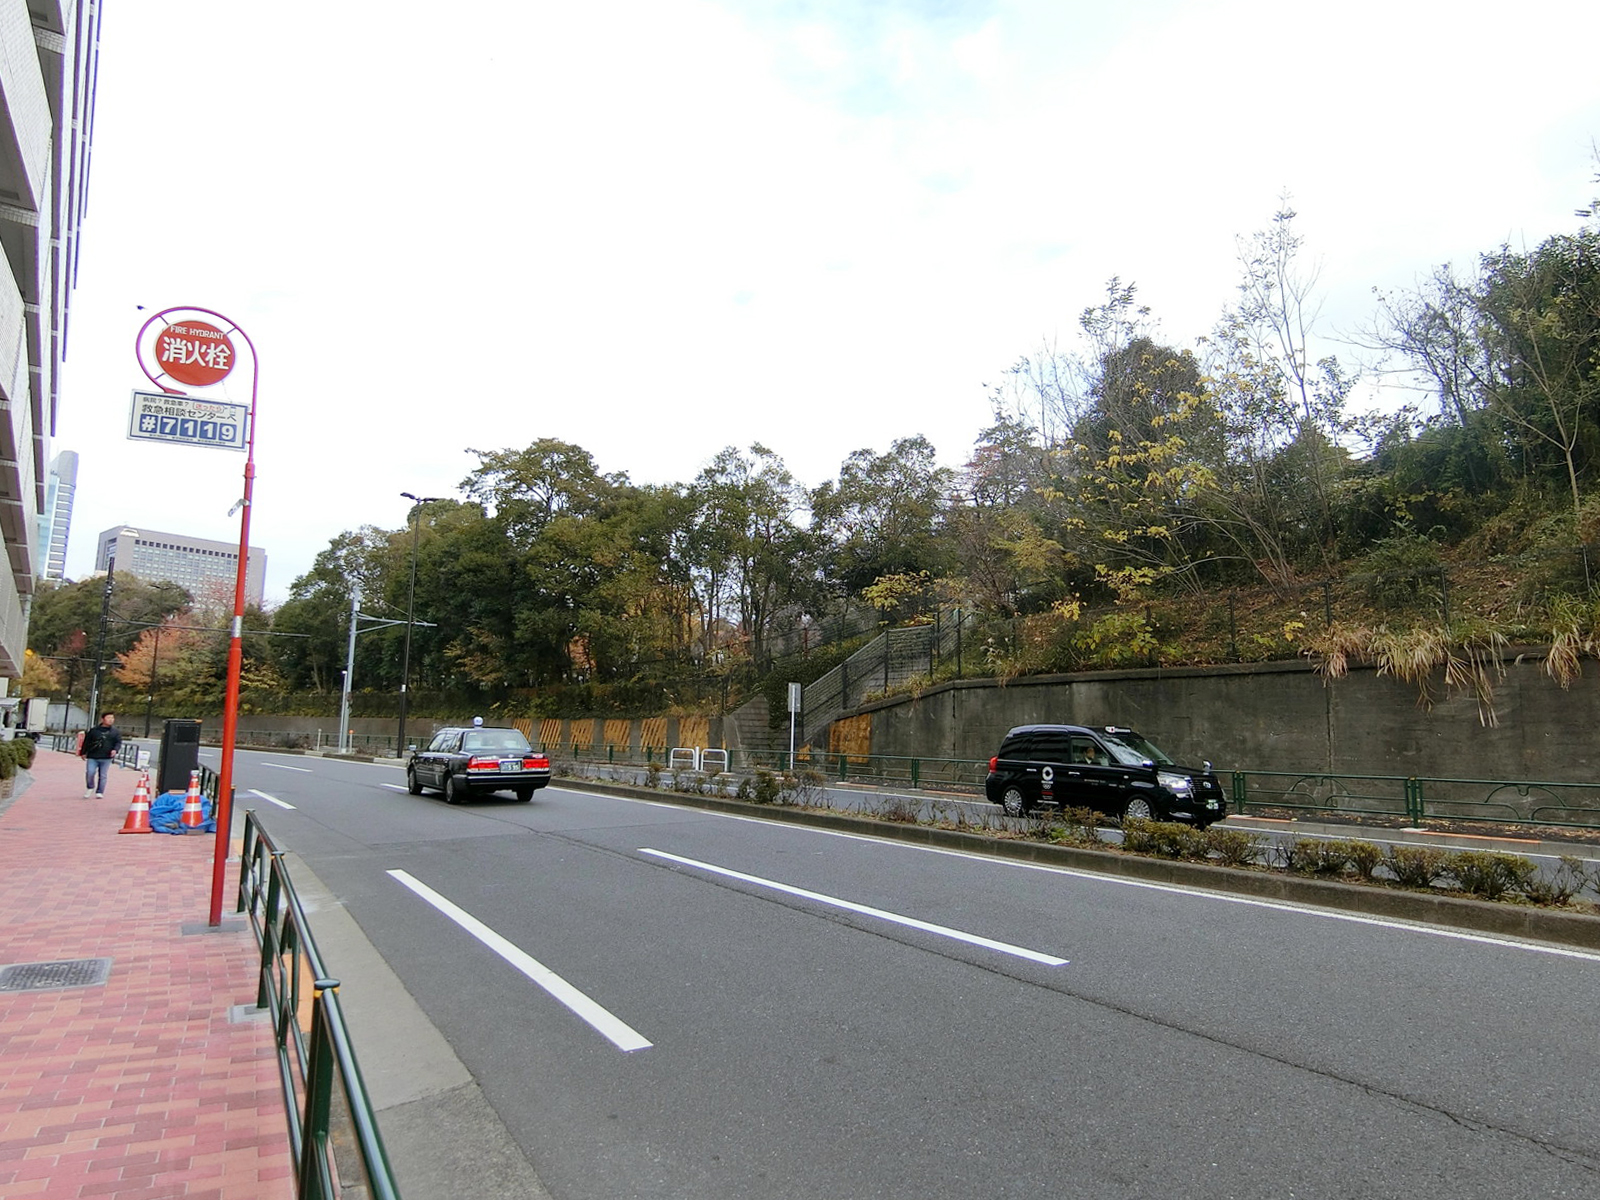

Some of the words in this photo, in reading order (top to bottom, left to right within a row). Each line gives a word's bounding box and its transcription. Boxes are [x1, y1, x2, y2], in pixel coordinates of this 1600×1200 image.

[170, 325, 188, 335] FIRE
[189, 328, 224, 340] HYDRANT
[162, 336, 231, 370] 消火栓
[141, 404, 237, 422] 救急相談センターへ
[141, 415, 234, 441] #7119
